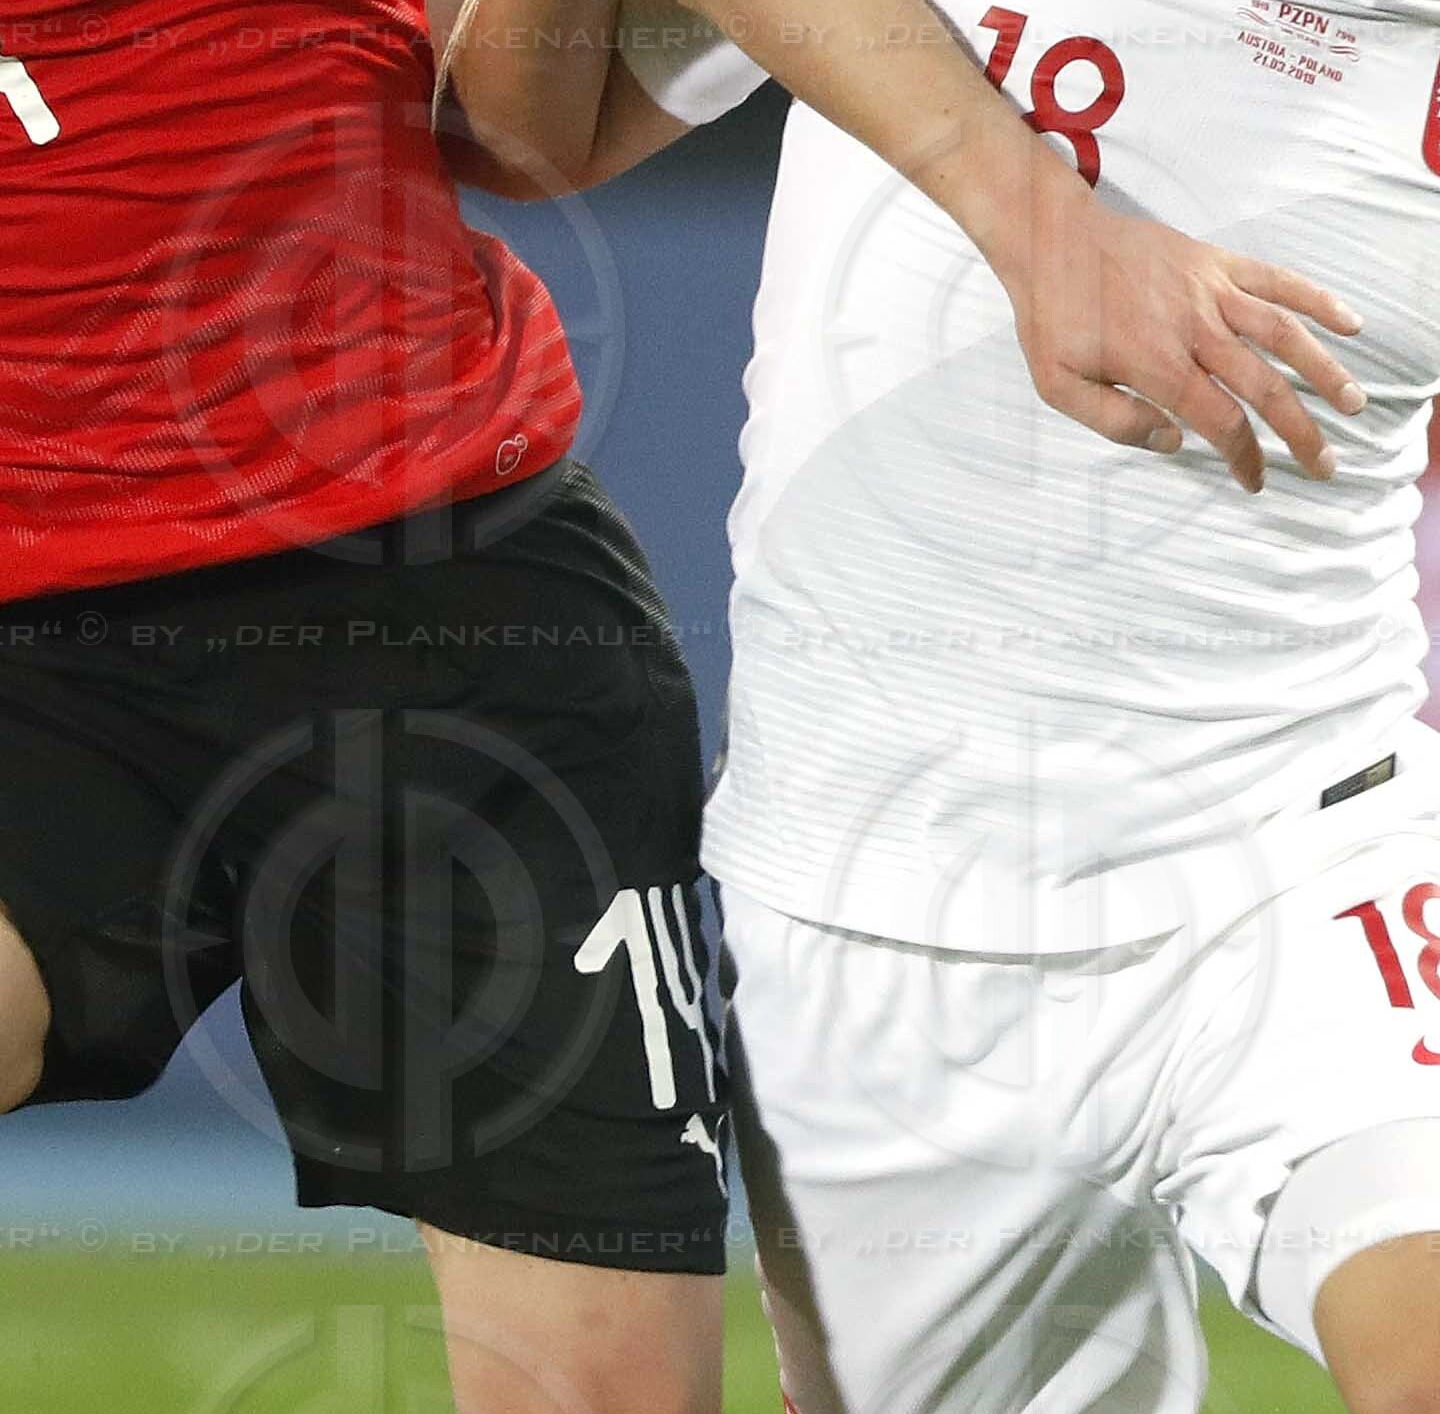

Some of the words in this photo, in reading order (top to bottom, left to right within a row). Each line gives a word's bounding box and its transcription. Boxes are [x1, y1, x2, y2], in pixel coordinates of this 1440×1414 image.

[1278, 3, 1330, 34] PZPN
[1237, 31, 1287, 57] AUSTRIA
[1298, 55, 1343, 82] POLAND
[1252, 52, 1317, 85] 21.03.2019
